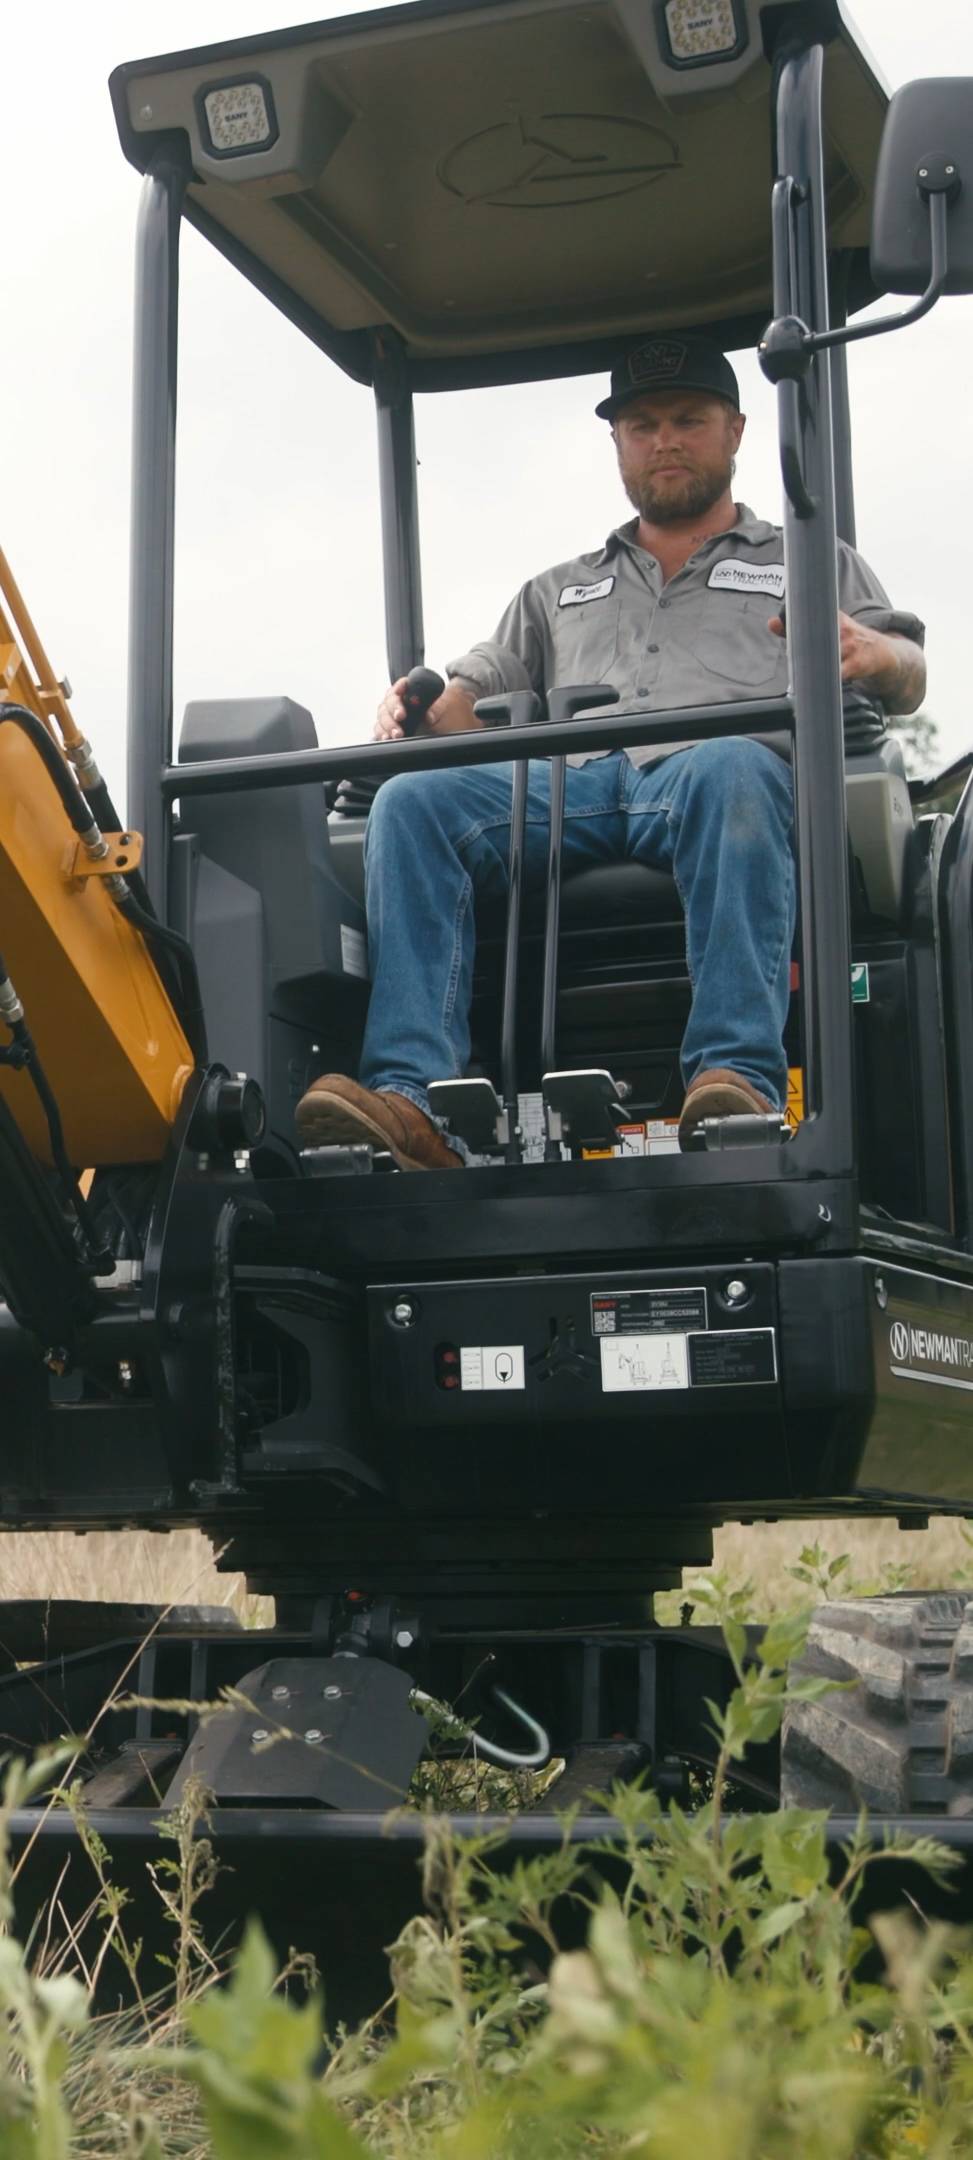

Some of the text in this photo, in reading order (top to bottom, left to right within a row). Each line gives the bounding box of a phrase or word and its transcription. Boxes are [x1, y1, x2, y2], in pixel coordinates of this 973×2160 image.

[687, 18, 713, 30] SANY
[225, 112, 248, 122] SANY
[733, 570, 783, 582] NEWMAN
